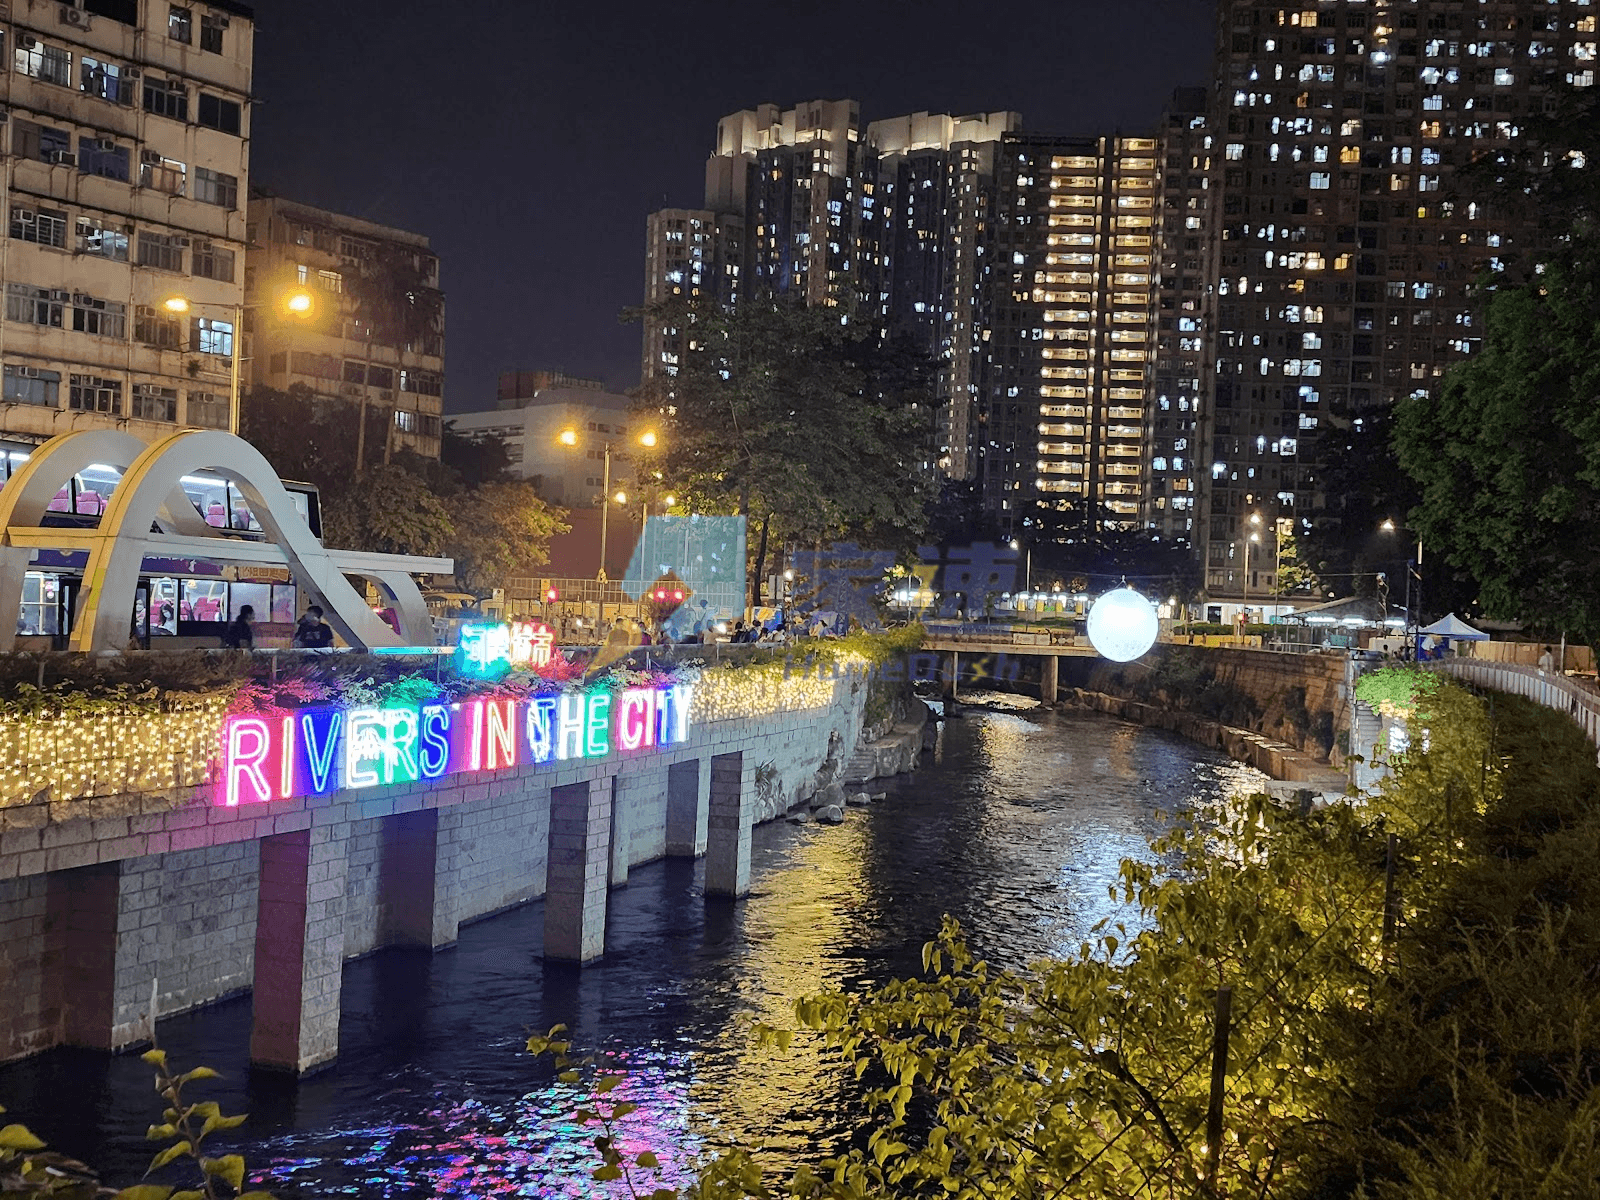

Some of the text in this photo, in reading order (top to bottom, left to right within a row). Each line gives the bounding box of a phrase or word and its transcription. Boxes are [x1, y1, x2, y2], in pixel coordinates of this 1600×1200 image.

[224, 685, 694, 807] RIVERS IN THE CITY
